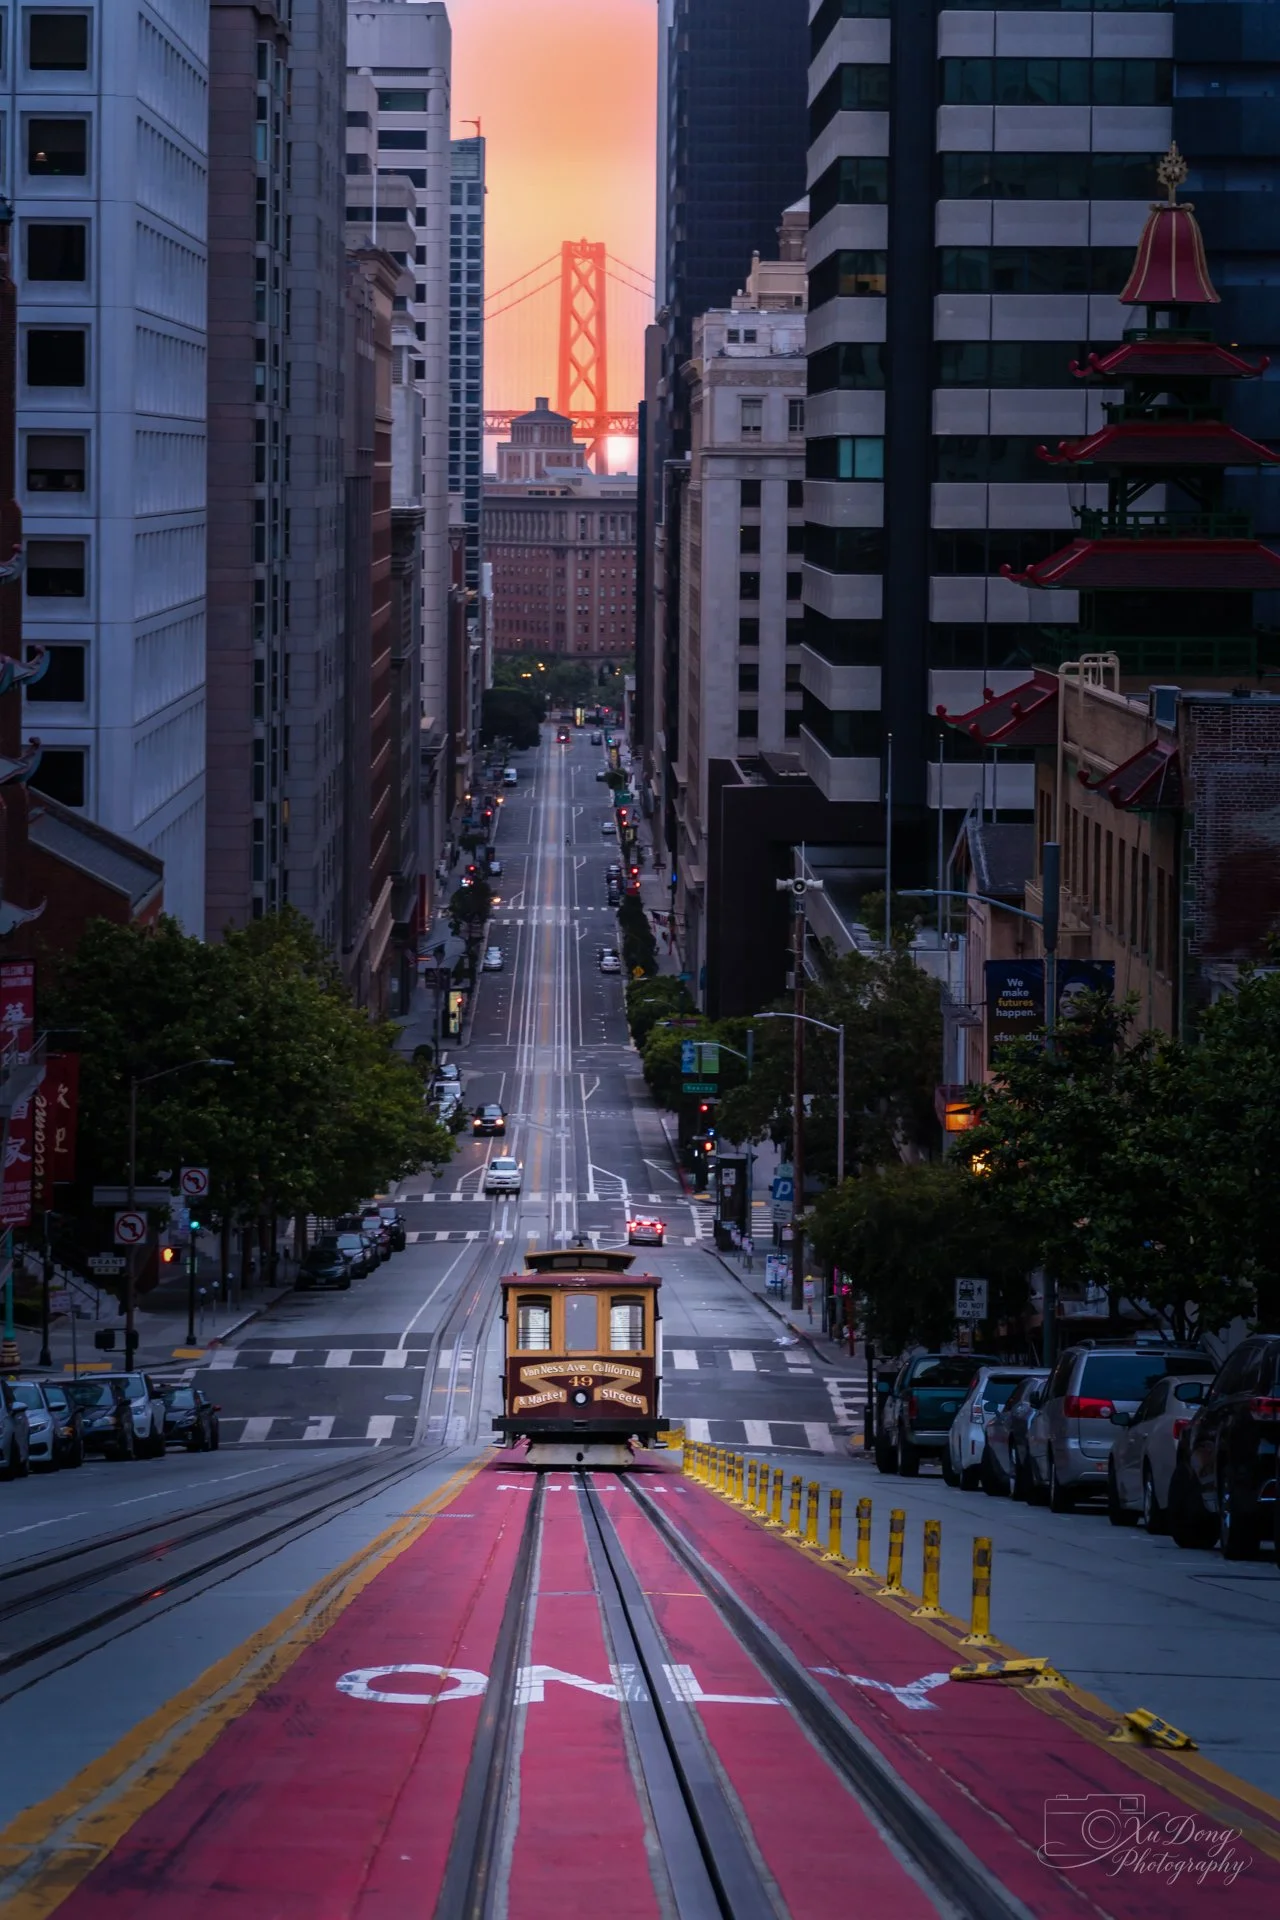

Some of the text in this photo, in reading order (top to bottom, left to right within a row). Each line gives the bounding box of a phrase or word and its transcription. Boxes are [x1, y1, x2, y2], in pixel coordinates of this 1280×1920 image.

[1007, 978, 1024, 987] We
[1003, 988, 1029, 997] make
[998, 998, 1034, 1007] futures
[996, 1008, 1037, 1019] happen.
[91, 1258, 125, 1266] GRANT
[962, 1310, 981, 1318] PASS
[523, 1368, 540, 1377] Van
[540, 1364, 564, 1374] Ness
[592, 1363, 641, 1378] California
[569, 1375, 593, 1387] 49
[528, 1391, 563, 1405] Market
[602, 1388, 642, 1404] Streets
[336, 1663, 951, 1710] ONLY
